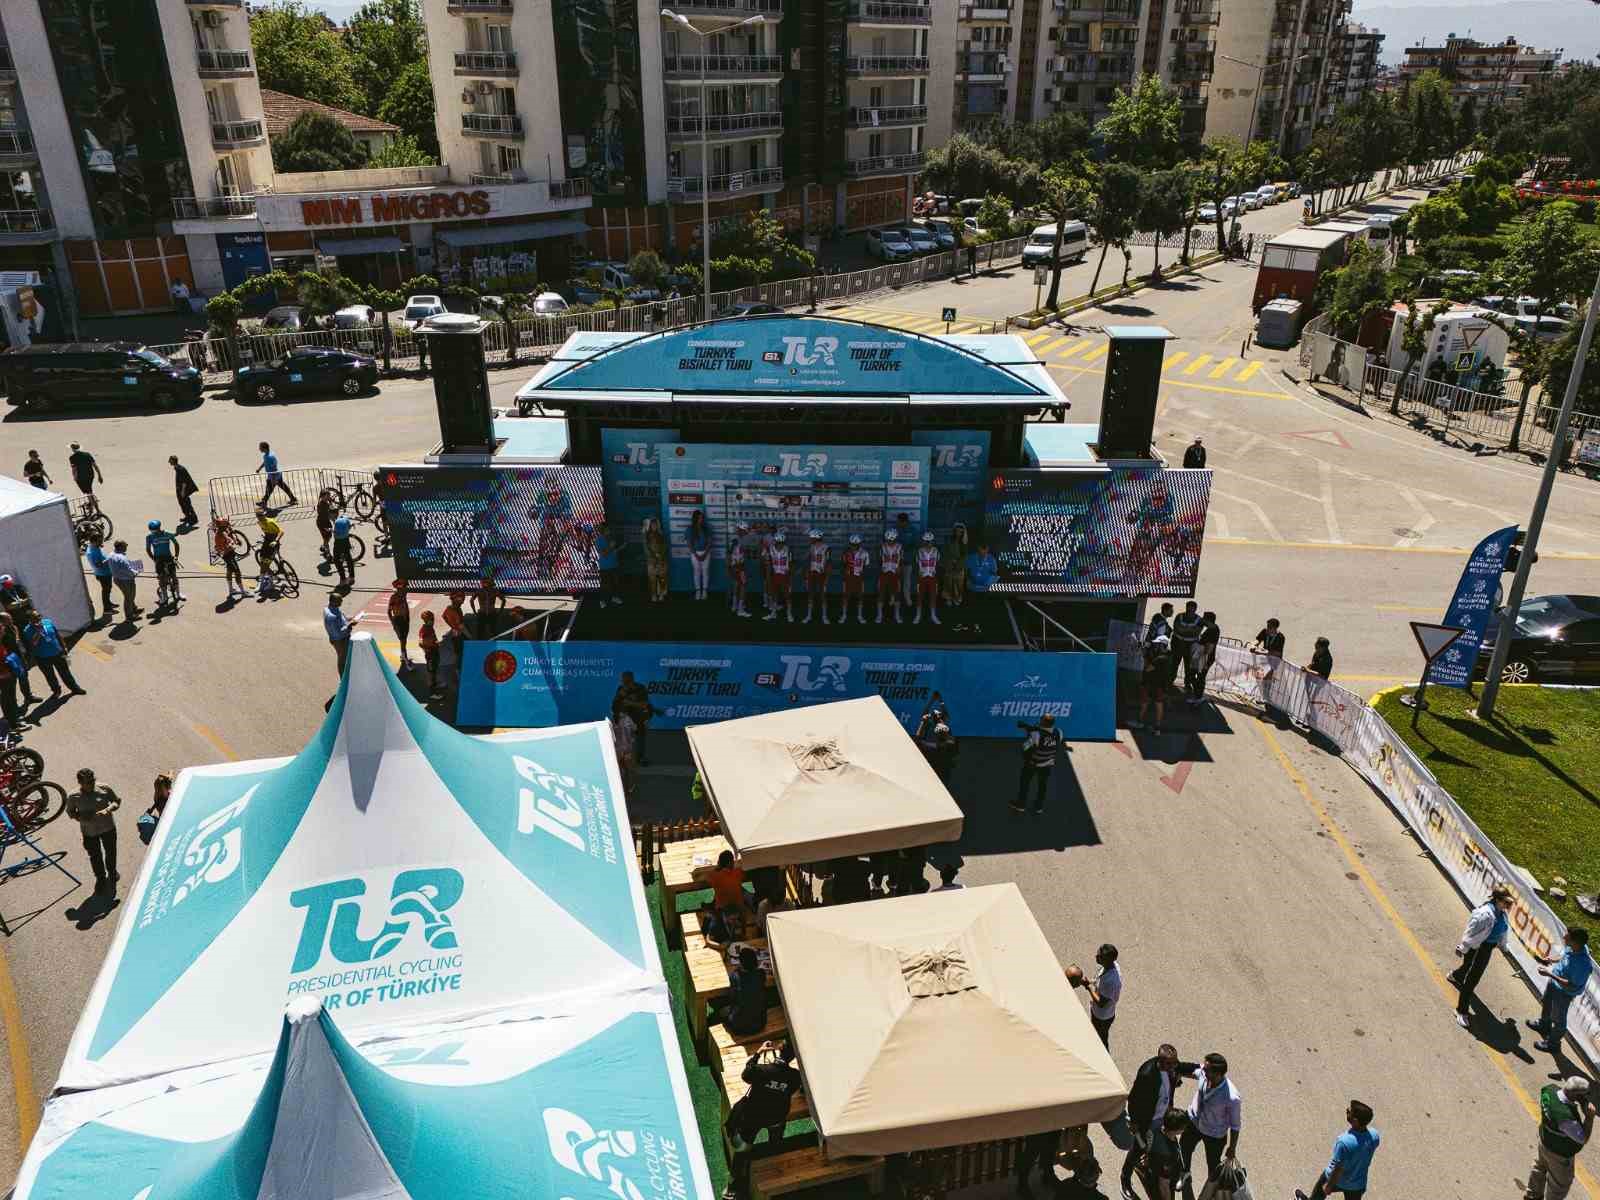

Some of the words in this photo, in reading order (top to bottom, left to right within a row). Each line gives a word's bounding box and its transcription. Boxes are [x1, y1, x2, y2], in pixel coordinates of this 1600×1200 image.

[302, 197, 362, 225] MM
[782, 337, 839, 366] TUR
[850, 348, 877, 359] TOUR
[880, 349, 895, 359] OF
[779, 453, 828, 477] TUR
[780, 656, 850, 691] TUR
[290, 867, 465, 974] TUR
[287, 964, 396, 995] PRESIDENTIAL
[400, 954, 463, 977] CYCLING
[346, 988, 375, 1008] OF
[377, 972, 462, 1003] TÜRKİYE
[640, 1128, 665, 1191] CYCLING
